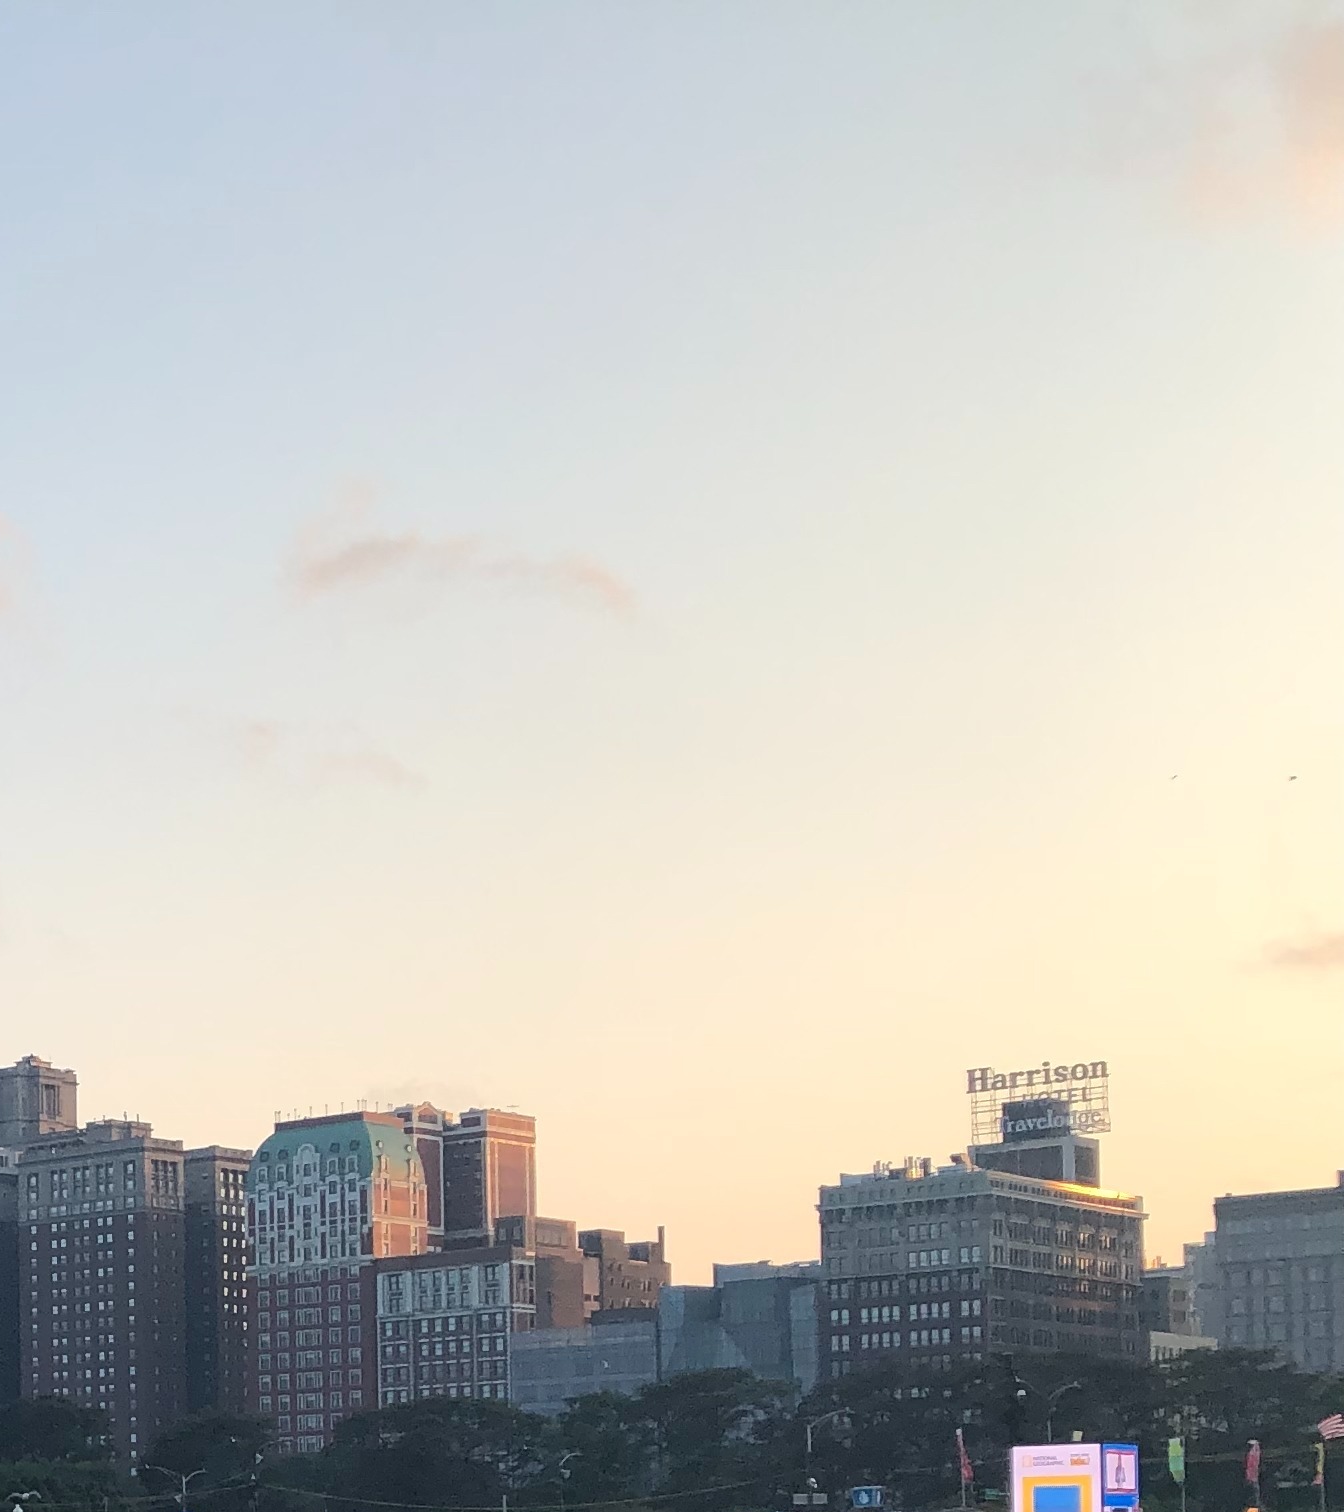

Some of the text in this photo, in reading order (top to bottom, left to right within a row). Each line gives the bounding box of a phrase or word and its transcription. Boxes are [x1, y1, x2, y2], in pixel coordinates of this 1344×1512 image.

[966, 1061, 1110, 1094] Harrison
[1022, 1087, 1089, 1107] HOTEL
[999, 1109, 1103, 1132] Travelodge
